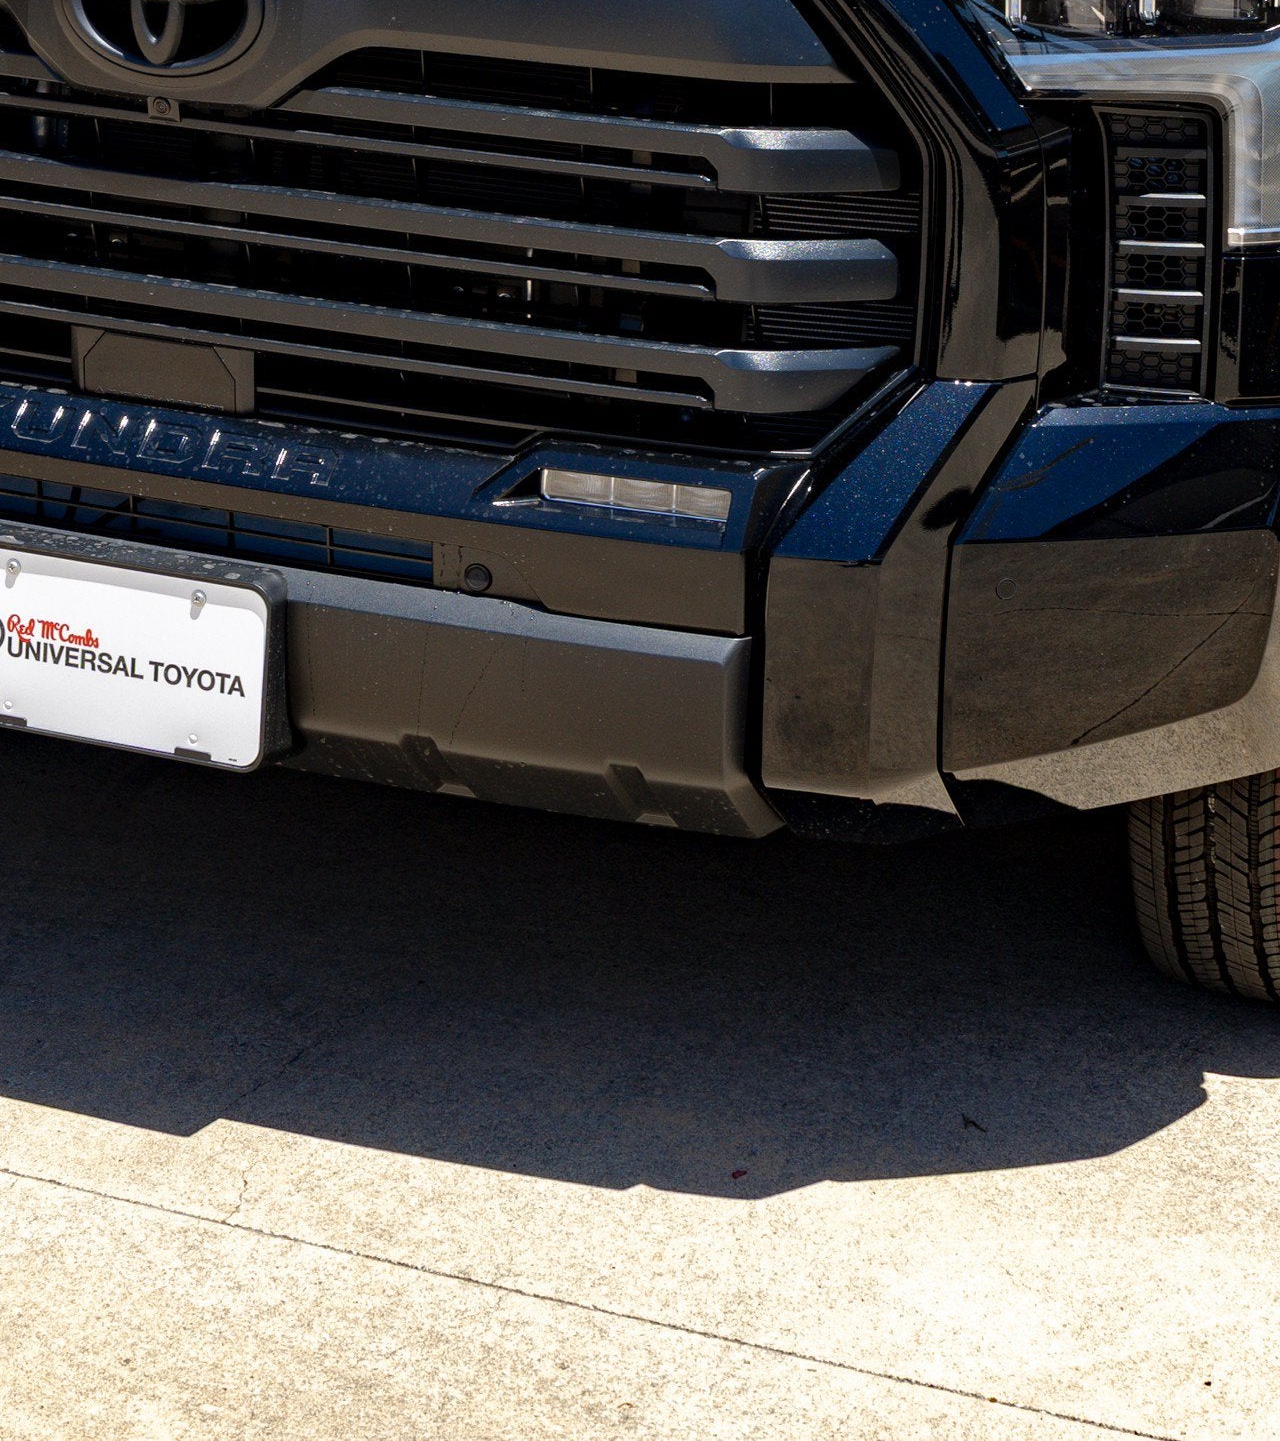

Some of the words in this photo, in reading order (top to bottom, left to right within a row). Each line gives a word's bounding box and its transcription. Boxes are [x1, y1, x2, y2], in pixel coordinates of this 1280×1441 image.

[7, 614, 35, 643] Red
[36, 619, 100, 649] McCombs
[7, 635, 144, 680] UNIVERSAL
[148, 661, 246, 698] TOYOTA
